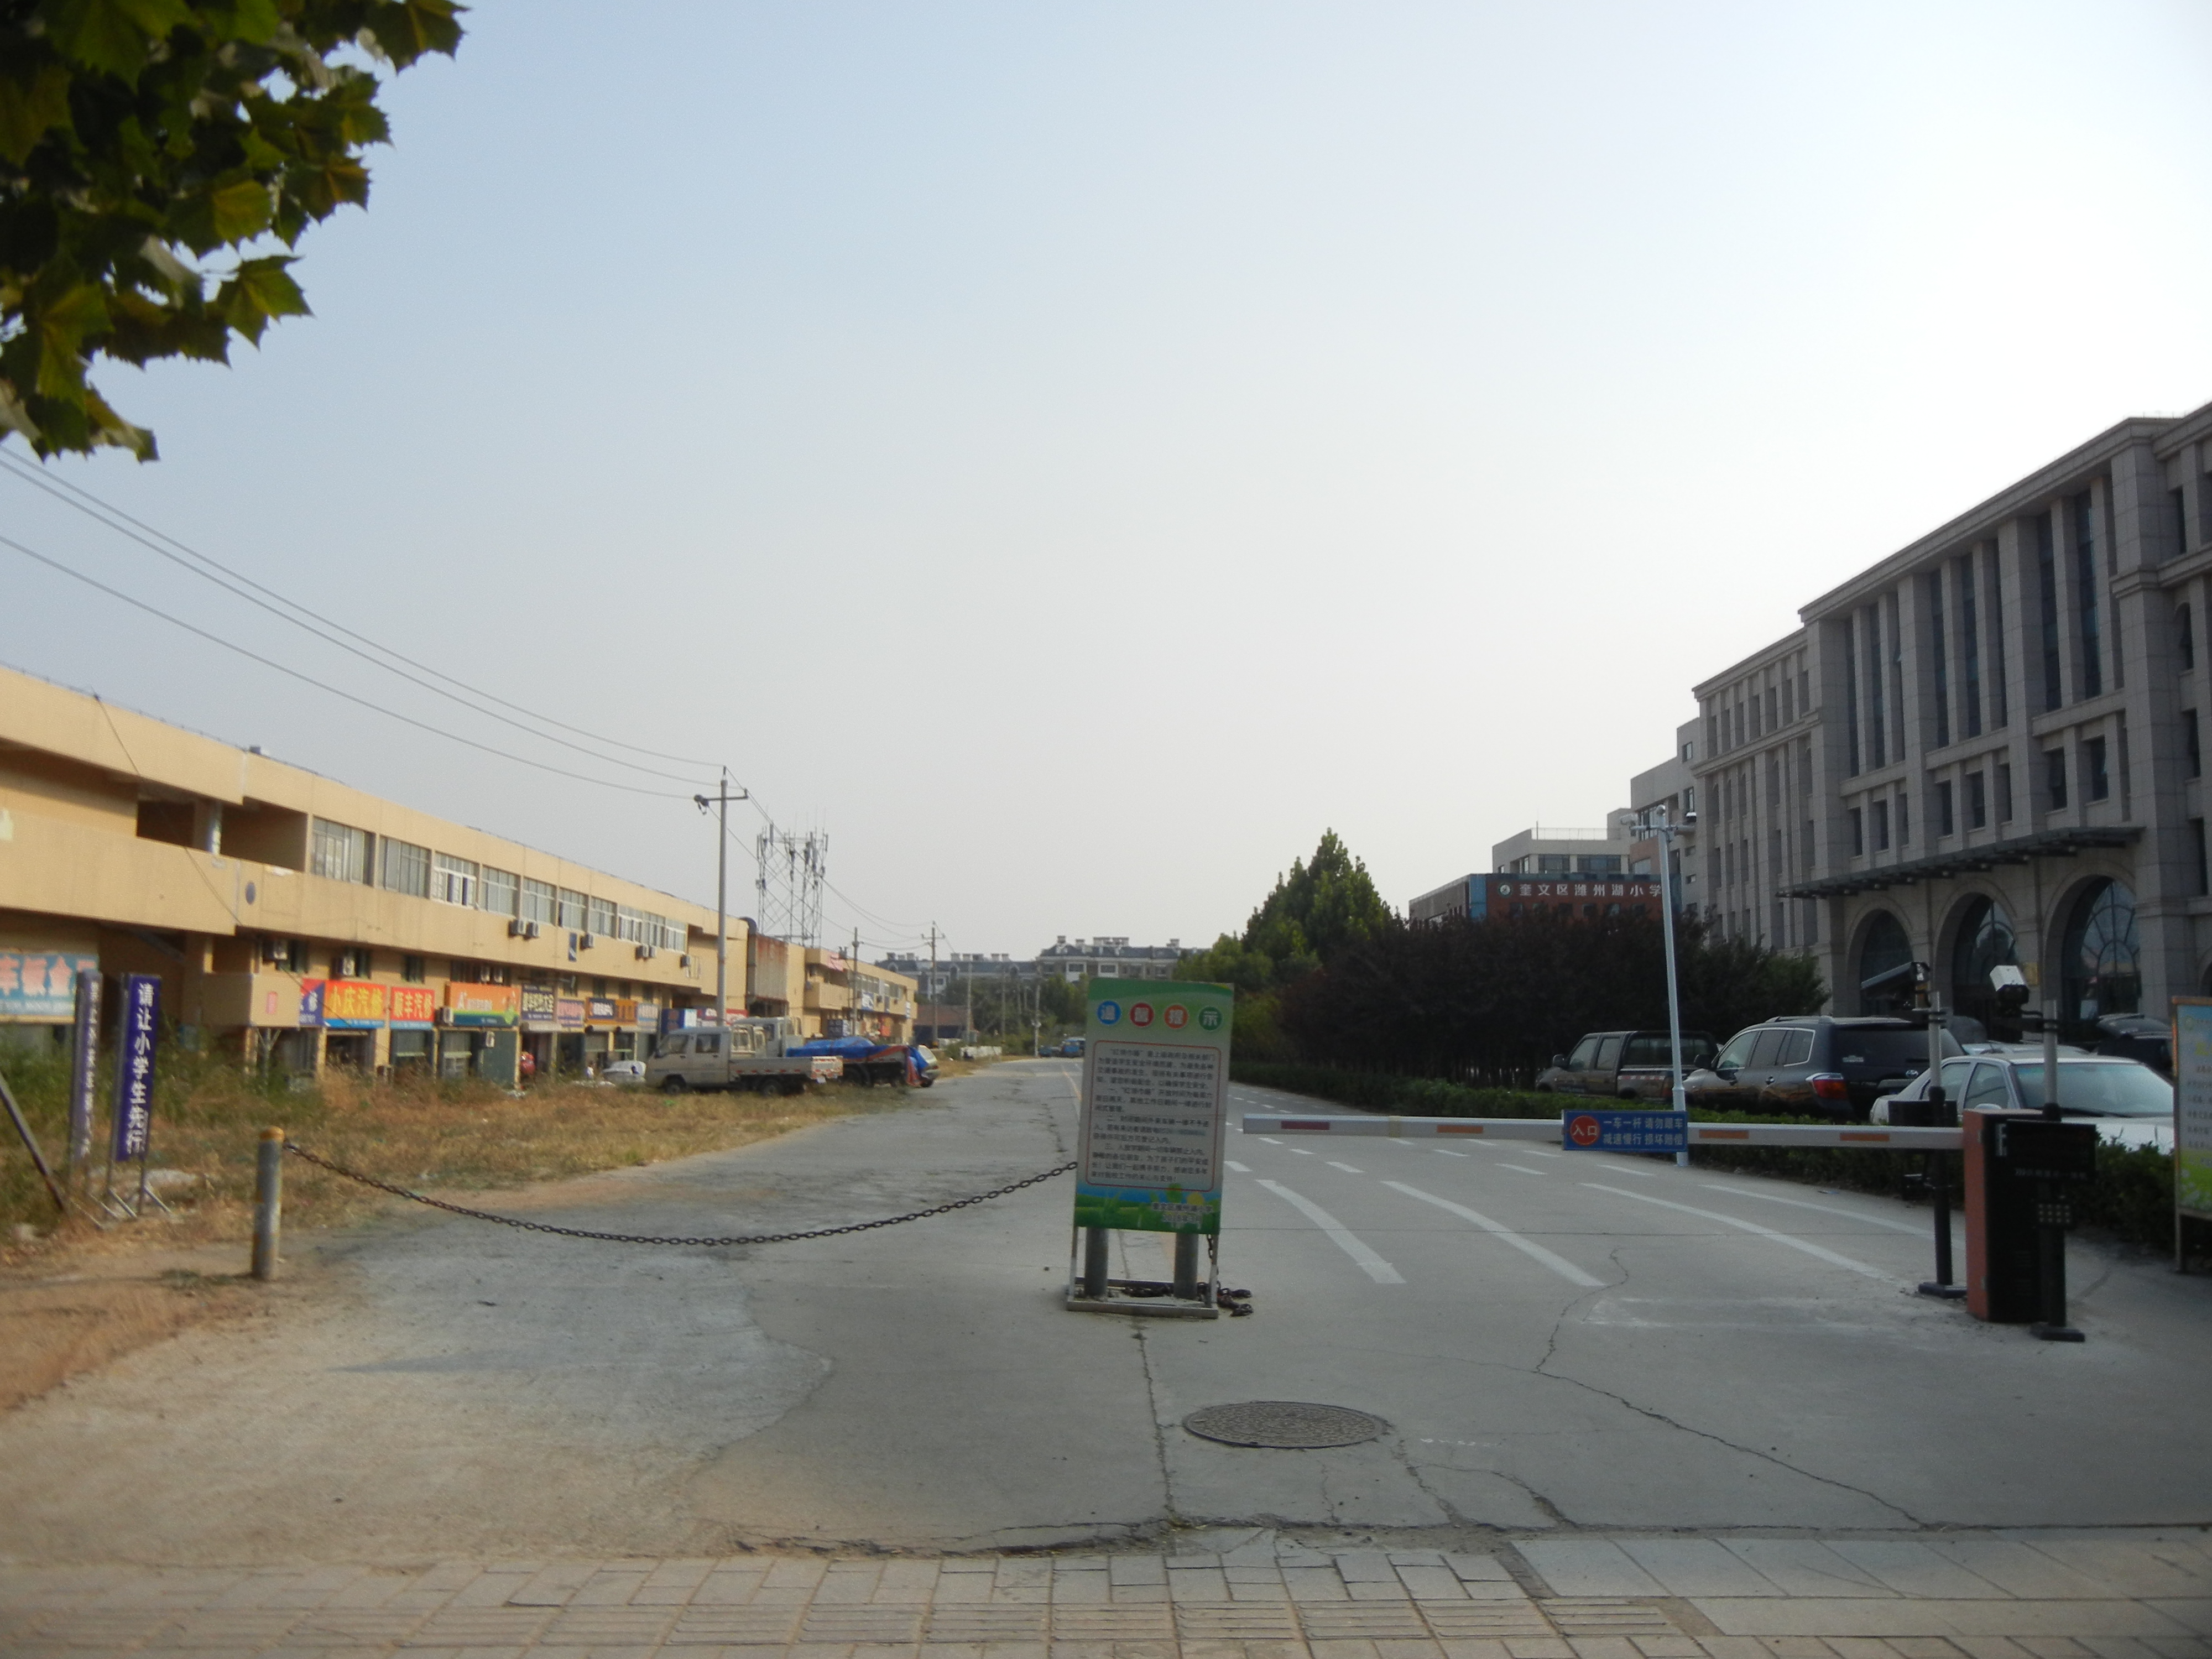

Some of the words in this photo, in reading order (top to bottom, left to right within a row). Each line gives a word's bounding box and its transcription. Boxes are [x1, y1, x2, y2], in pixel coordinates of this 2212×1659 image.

[1519, 884, 1662, 897] 奎文区潍州湖小学
[1603, 1117, 1641, 1129] 一车一杆
[1645, 1117, 1683, 1129] 请勿跟车
[1572, 1124, 1597, 1137] 入口
[1603, 1133, 1641, 1145] 减速慢行
